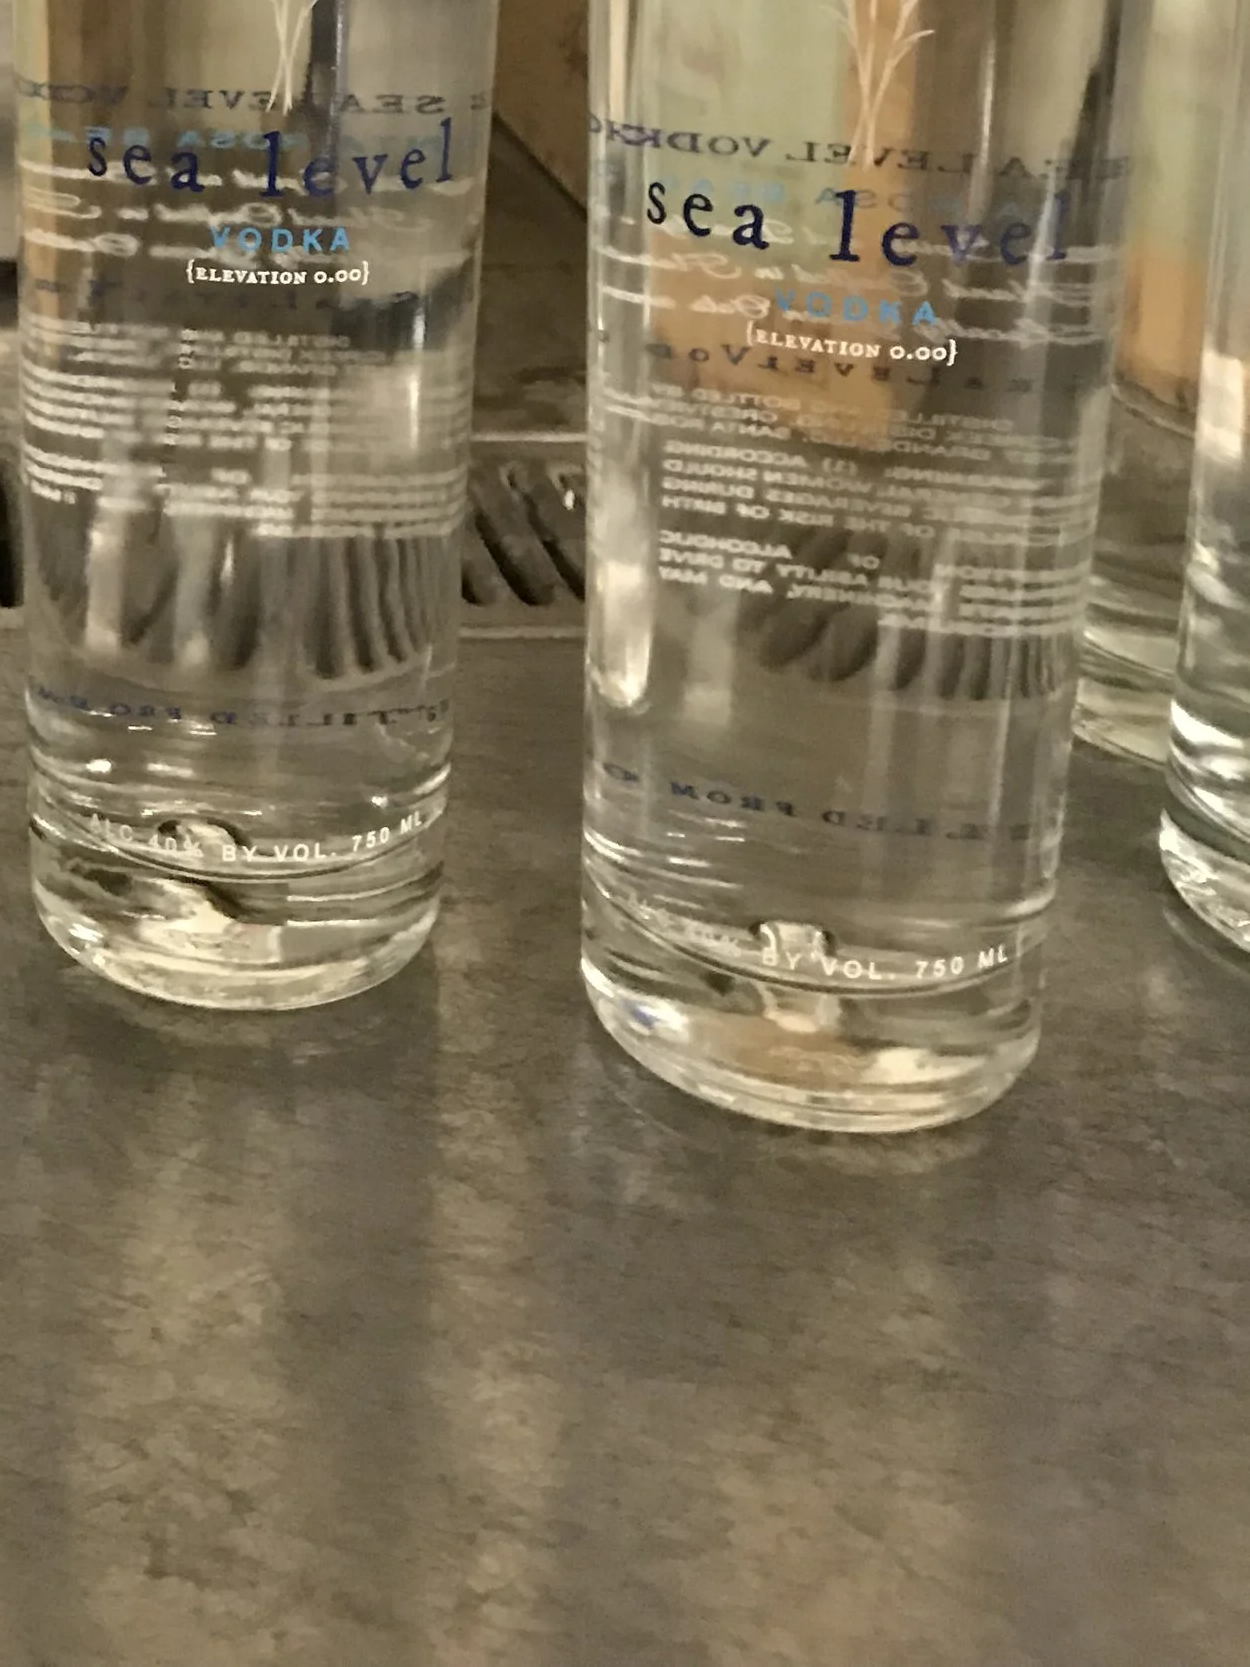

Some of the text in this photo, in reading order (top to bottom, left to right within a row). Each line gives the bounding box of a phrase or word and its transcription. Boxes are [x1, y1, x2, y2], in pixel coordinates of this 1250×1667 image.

[86, 118, 453, 198] sea level
[210, 226, 351, 253] VODKA
[646, 180, 770, 251] sea
[828, 188, 1069, 266] level
[774, 287, 941, 328] VODKA
[222, 845, 258, 863] BY
[273, 842, 338, 863] VOL.
[350, 826, 391, 852] 750
[398, 810, 426, 835] ML
[820, 956, 898, 982] VOL.
[914, 954, 967, 980] 750
[975, 944, 1009, 970] ML
